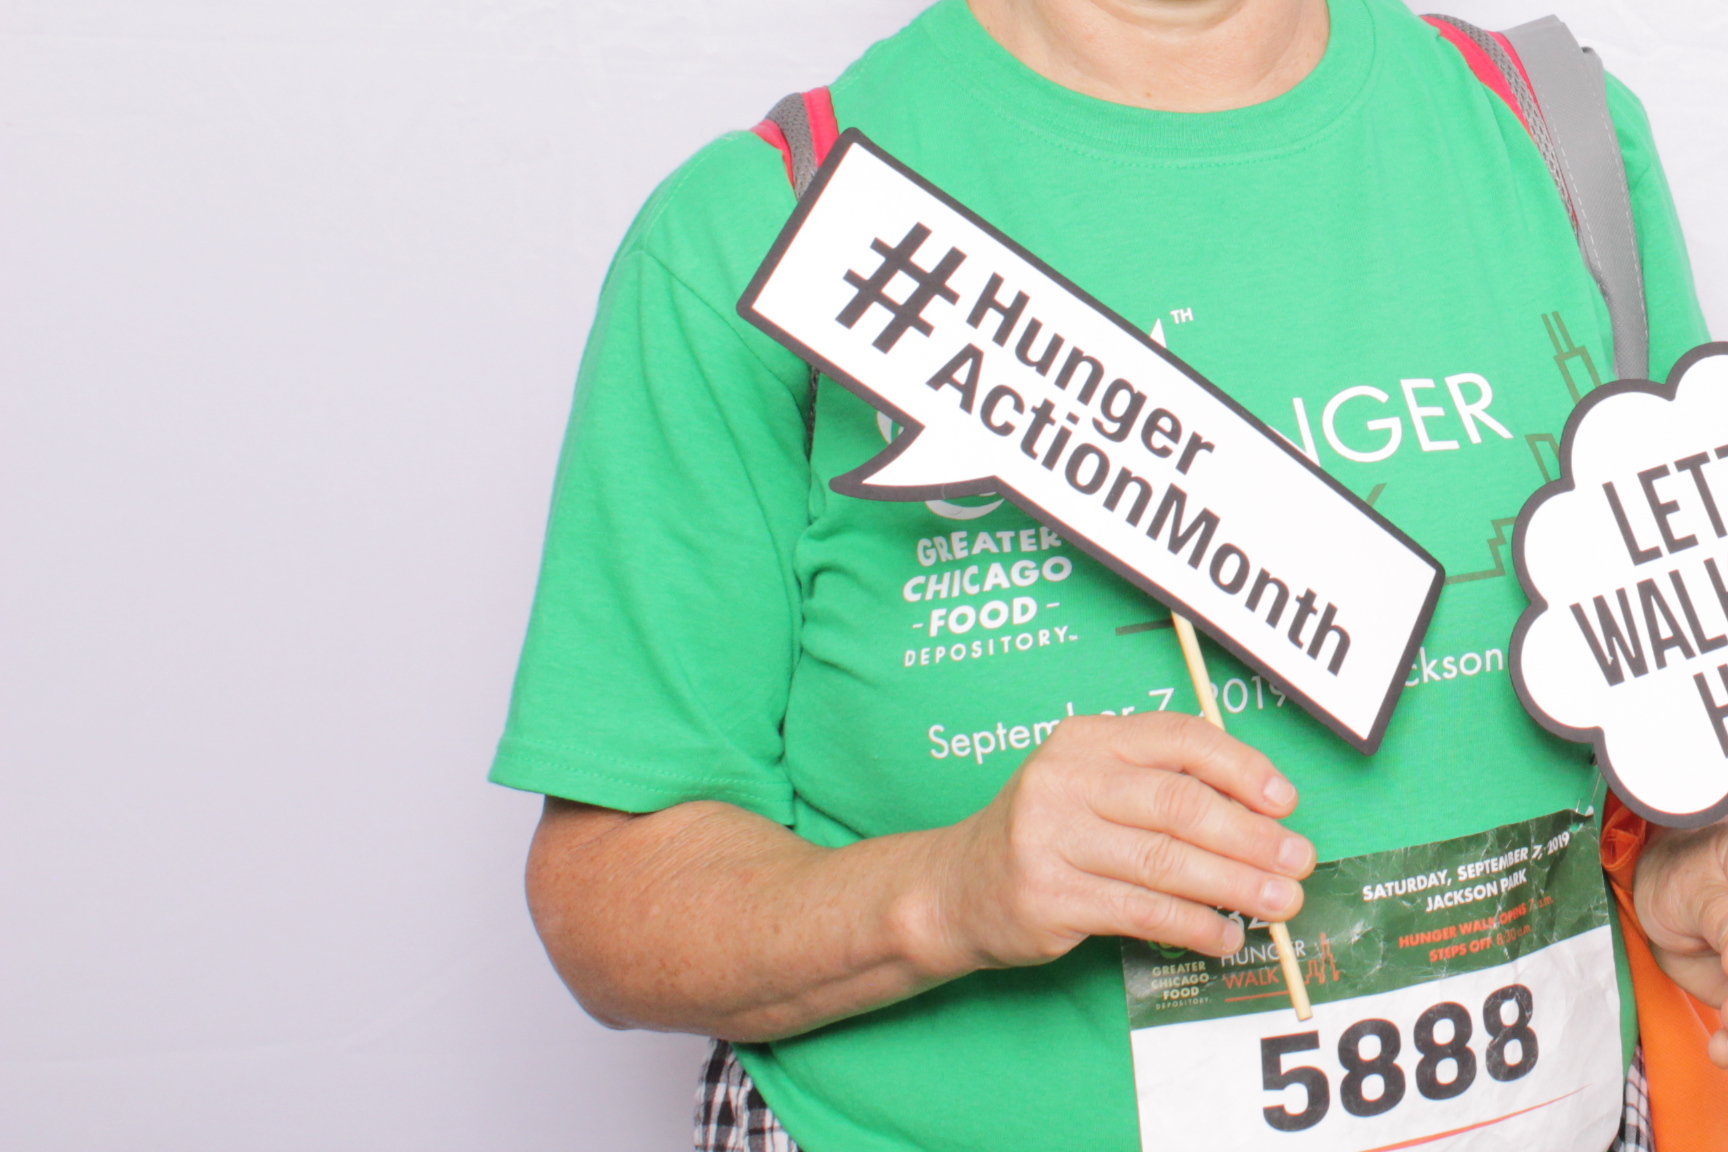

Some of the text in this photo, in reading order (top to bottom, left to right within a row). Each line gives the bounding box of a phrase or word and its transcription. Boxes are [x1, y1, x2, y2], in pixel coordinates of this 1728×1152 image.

[925, 343, 1352, 678] ActionMonth
[917, 526, 1062, 567] GREATER
[902, 556, 1073, 602] CHICAGO
[1362, 869, 1453, 901] SATURDAY,
[1457, 846, 1529, 882] SEPTEMBER
[1547, 831, 1570, 855] 2019
[1425, 868, 1528, 913] JACKSON PARK
[1399, 927, 1458, 949] HUNGER
[1458, 916, 1497, 935] WALK
[1221, 939, 1306, 967] HUNGR
[1429, 943, 1468, 963] STEPS
[1471, 936, 1493, 953] OFF
[1151, 973, 1210, 990] CHICAGO
[1152, 961, 1206, 976] GREATER
[1223, 967, 1280, 990] WALK
[1163, 986, 1200, 1001] FOOD
[1260, 984, 1540, 1133] 5888
